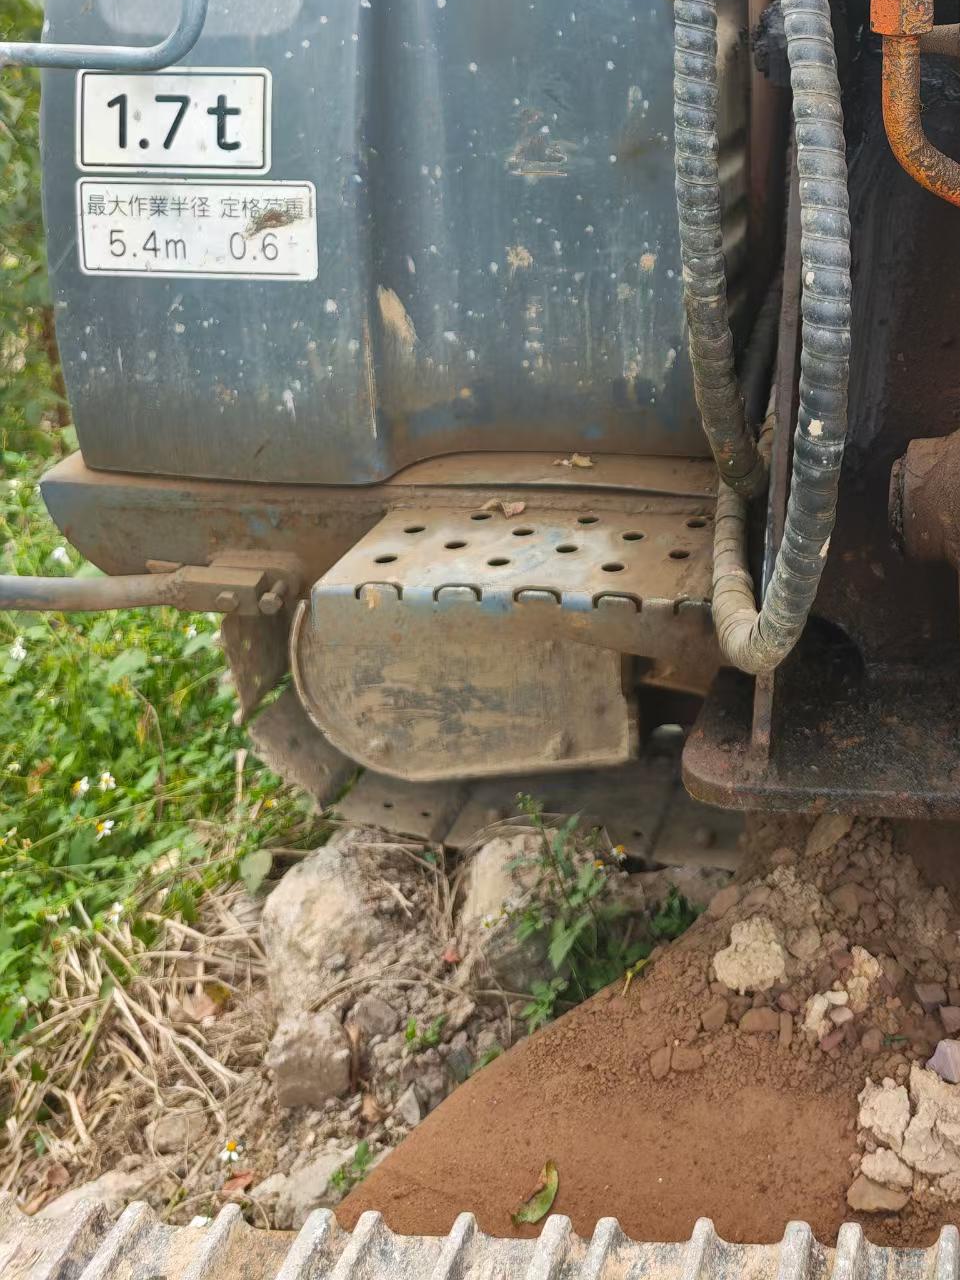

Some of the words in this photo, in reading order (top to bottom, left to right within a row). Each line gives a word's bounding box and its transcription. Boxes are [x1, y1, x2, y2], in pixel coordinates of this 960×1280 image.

[107, 93, 242, 151] 1.7t
[87, 194, 211, 218] 最大作業半径
[109, 229, 187, 260] 5.4m
